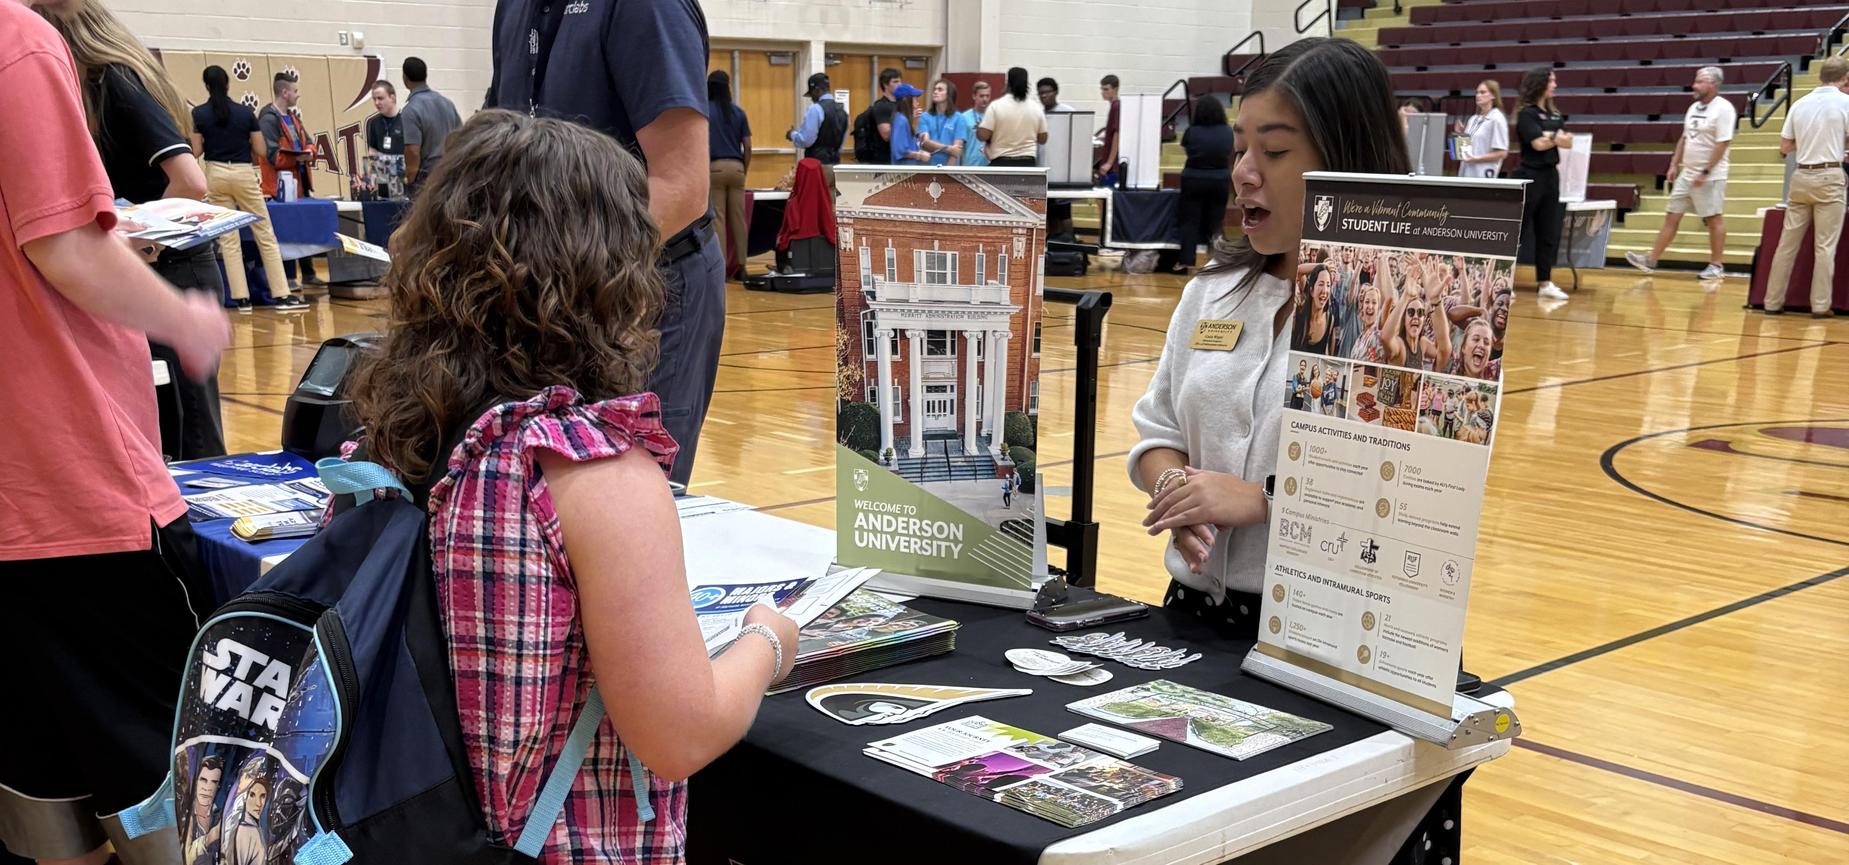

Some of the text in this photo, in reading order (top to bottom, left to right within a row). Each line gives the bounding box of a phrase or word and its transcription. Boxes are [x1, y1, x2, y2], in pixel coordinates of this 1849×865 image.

[1371, 199, 1401, 218] Vibrant
[1401, 201, 1450, 226] Community
[1341, 218, 1509, 241] STUDENT LIFE at ANDERSON UNIVERSITY
[1208, 322, 1237, 330] ANDERSON
[1380, 378, 1397, 392] JOY
[1290, 420, 1410, 452] CAMPUS ACTIVITIES AND TRADITIONS
[1403, 464, 1421, 475] 7000
[854, 499, 917, 516] WELCOME TO
[1285, 507, 1304, 519] Campus
[854, 511, 964, 541] ANDERSON
[1279, 517, 1312, 544] BCM
[854, 530, 963, 560] UNIVERSITY
[1319, 538, 1339, 555] cru
[729, 583, 785, 596] MAJORS
[1275, 564, 1391, 604] ATHLETICS AND INTRAMURAL SPORTS
[202, 637, 292, 700] STA
[199, 665, 287, 733] WAR
